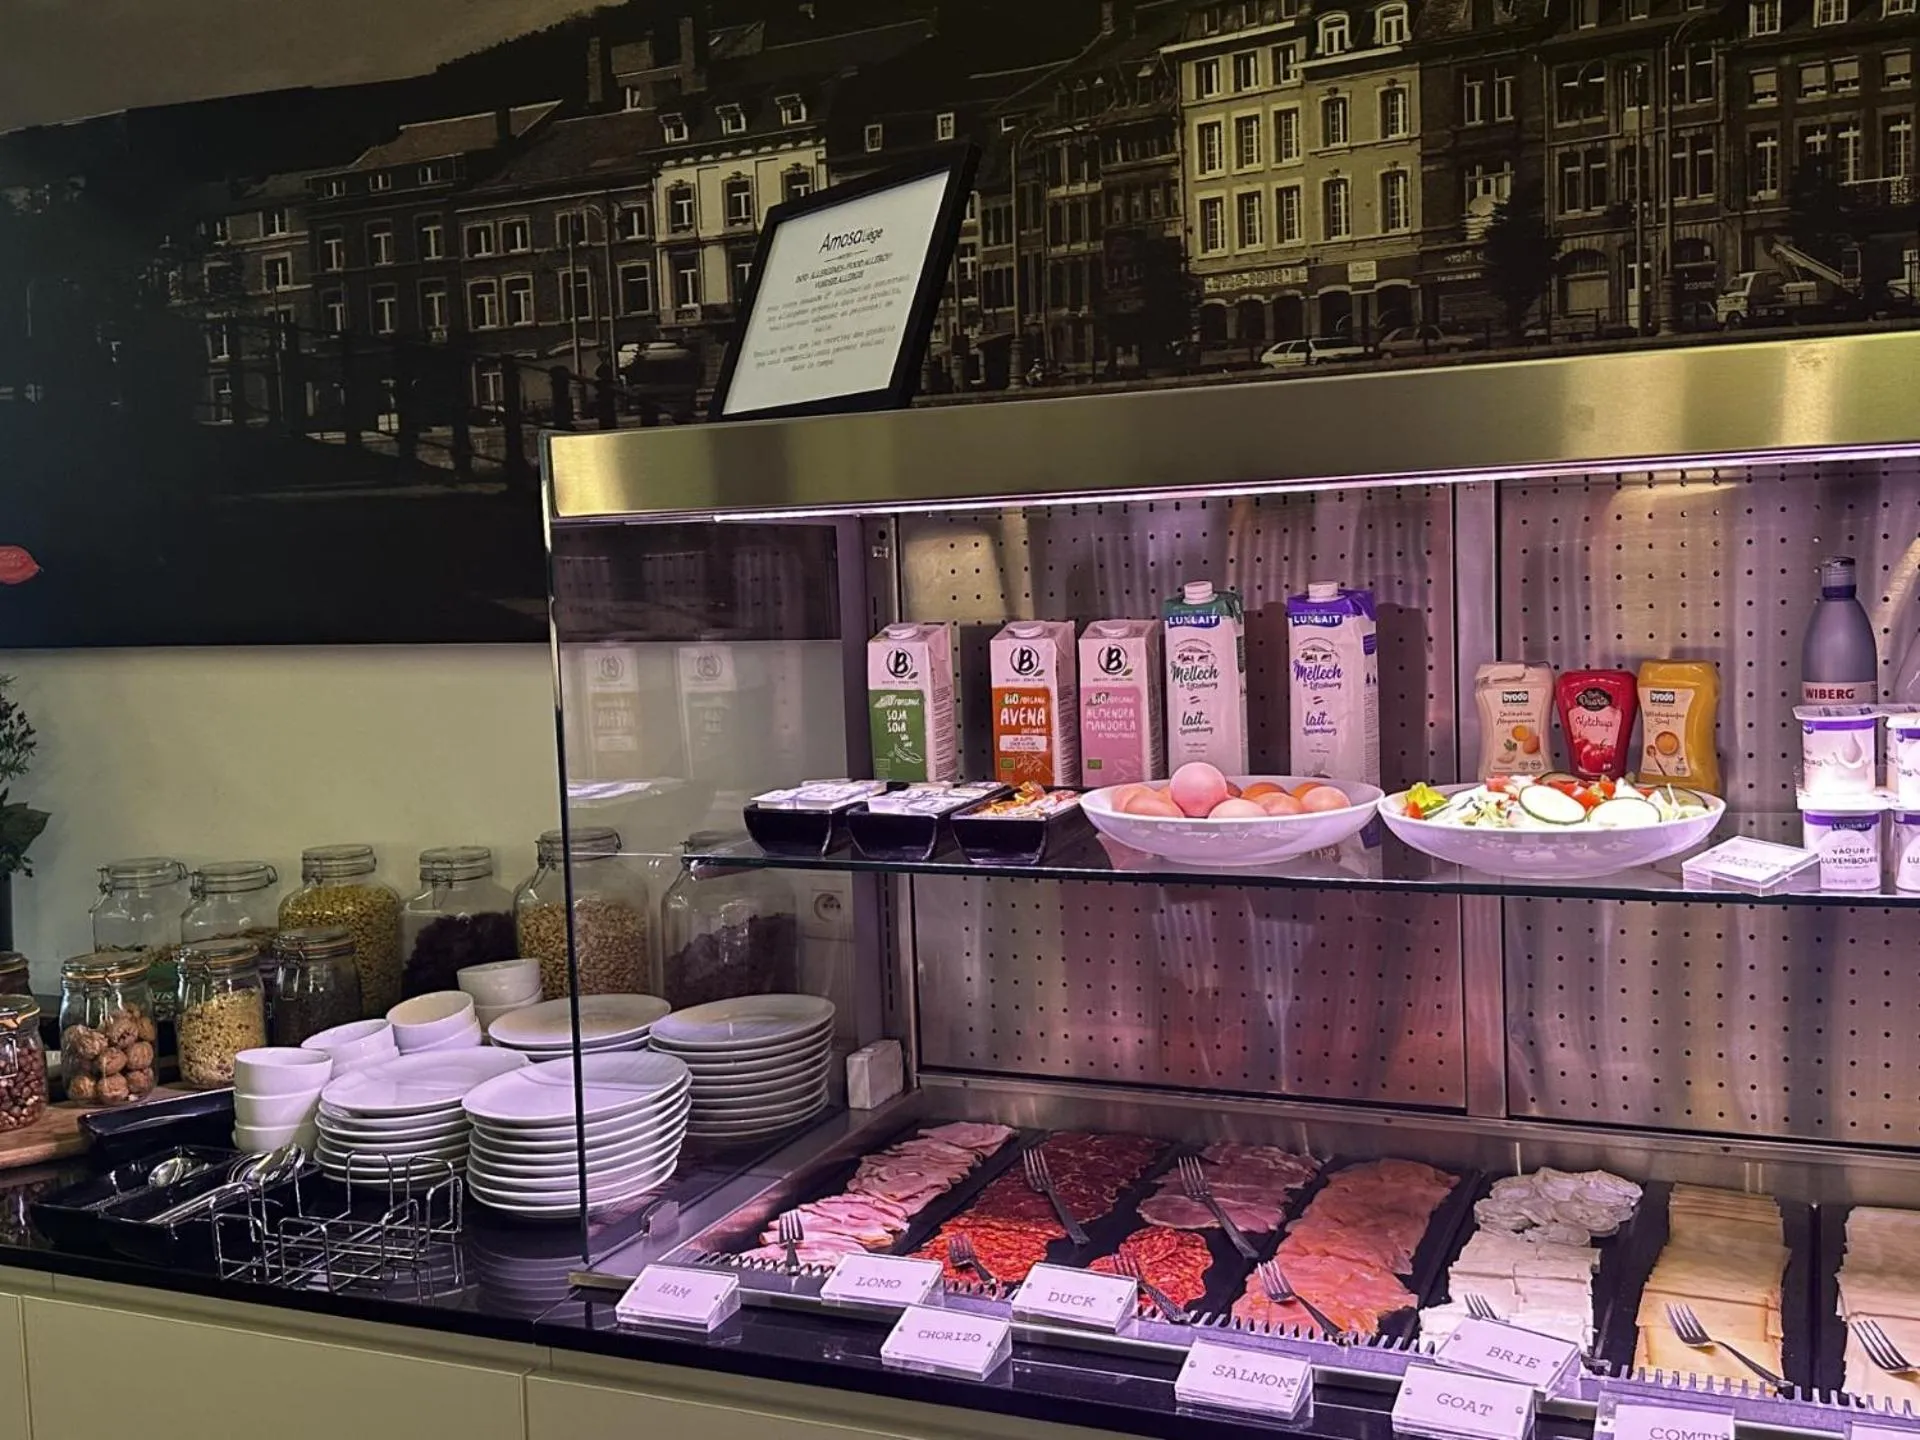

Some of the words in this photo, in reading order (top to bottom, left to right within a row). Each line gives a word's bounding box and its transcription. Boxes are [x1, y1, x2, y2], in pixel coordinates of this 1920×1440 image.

[893, 649, 908, 674] B
[1019, 647, 1034, 672] B
[1106, 646, 1122, 671] B
[1805, 688, 1855, 700] WIBERG
[1000, 707, 1046, 726] AVENA
[657, 1282, 692, 1298] HAM
[855, 1276, 901, 1289] LOMO
[1047, 1291, 1095, 1308] DUCK
[917, 1329, 982, 1343] CHORIZO
[1486, 1346, 1540, 1370] BRIE
[1212, 1364, 1290, 1389] SALMON
[1436, 1393, 1493, 1417] GOAT
